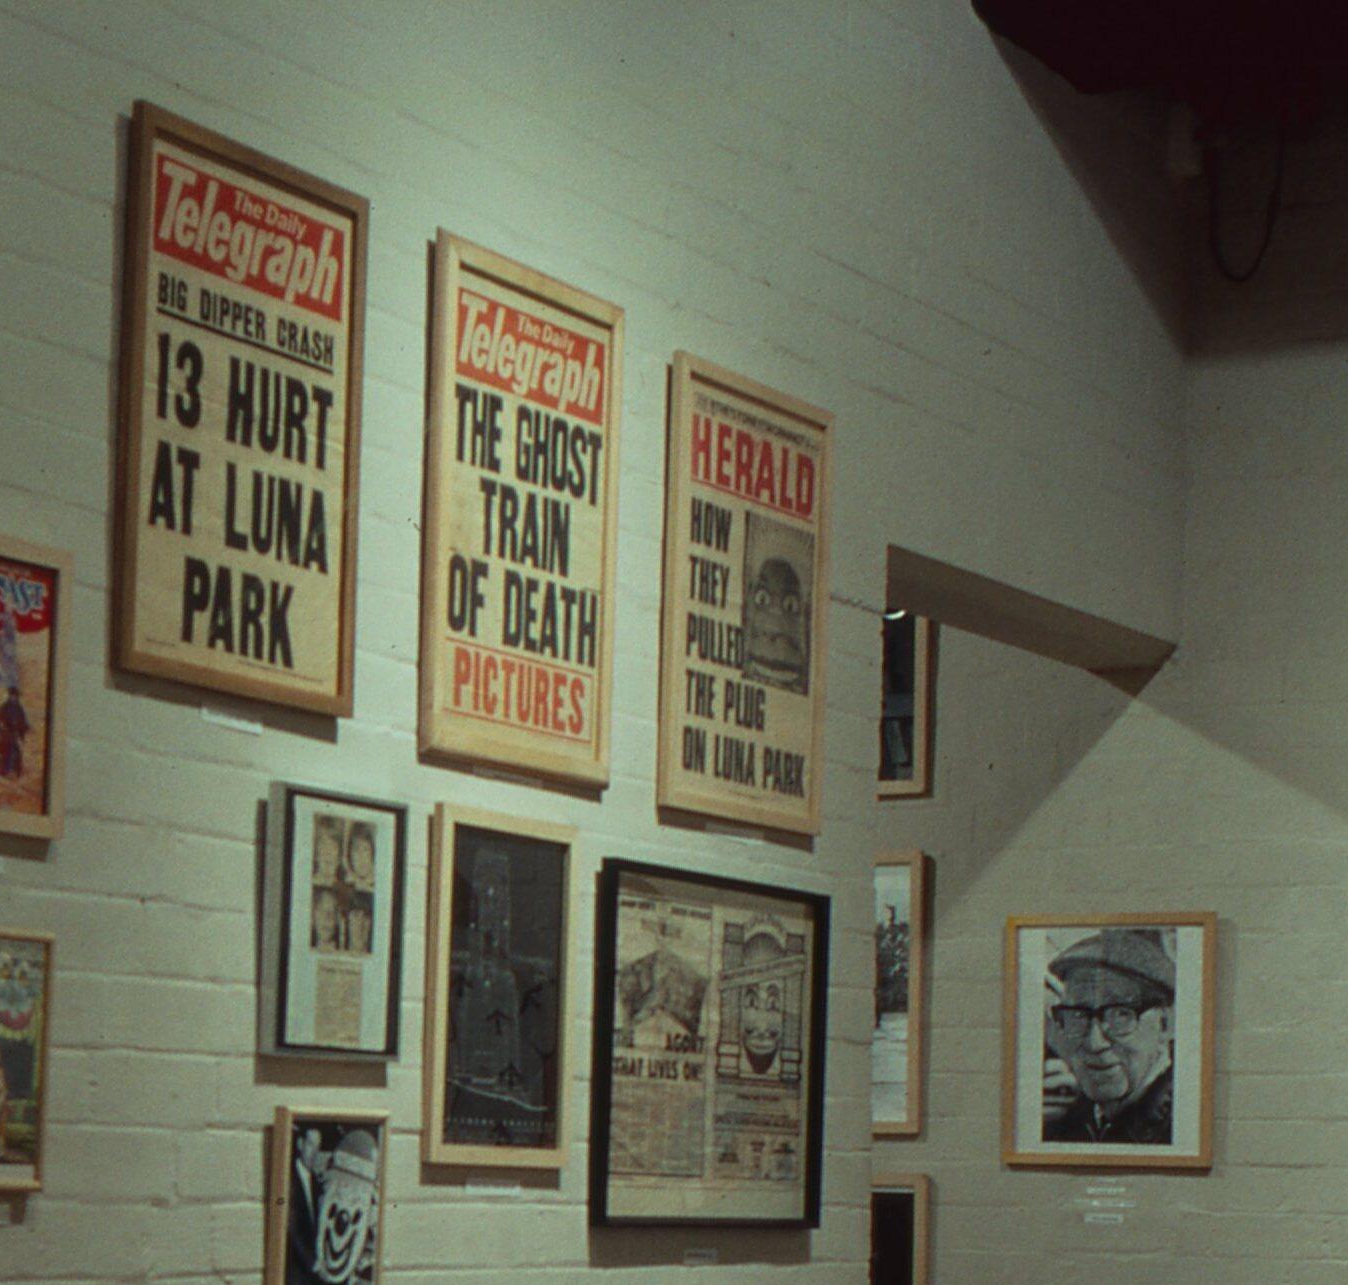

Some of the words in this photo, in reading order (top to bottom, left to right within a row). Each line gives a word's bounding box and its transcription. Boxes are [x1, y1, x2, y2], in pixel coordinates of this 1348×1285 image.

[157, 160, 339, 305] Telegraph
[235, 190, 263, 218] The
[264, 202, 308, 240] Daily
[157, 271, 188, 312] BIG
[200, 288, 266, 341] DIPPER
[276, 318, 334, 366] CRASH
[457, 292, 601, 412] Telegraph
[518, 315, 541, 339] The
[542, 323, 575, 355] Daily
[157, 332, 204, 430] 13
[226, 355, 333, 472] HURT
[455, 383, 503, 474] THE
[515, 404, 602, 507] GHOST
[148, 439, 200, 536] AT
[225, 461, 328, 576] LUNA
[691, 413, 815, 519] HERALD
[479, 476, 571, 579] TRAIN
[690, 496, 732, 554] HOW
[181, 555, 294, 670] PARK
[448, 553, 489, 638] OF
[503, 567, 597, 669] DEATH
[689, 554, 730, 610] THEY
[452, 645, 586, 735] PICTURES
[685, 611, 746, 671] PULLED
[685, 667, 715, 720] THE
[723, 678, 767, 733] PLUG
[682, 724, 706, 775] ON
[713, 732, 756, 788] LUNA
[762, 745, 805, 799] PARK
